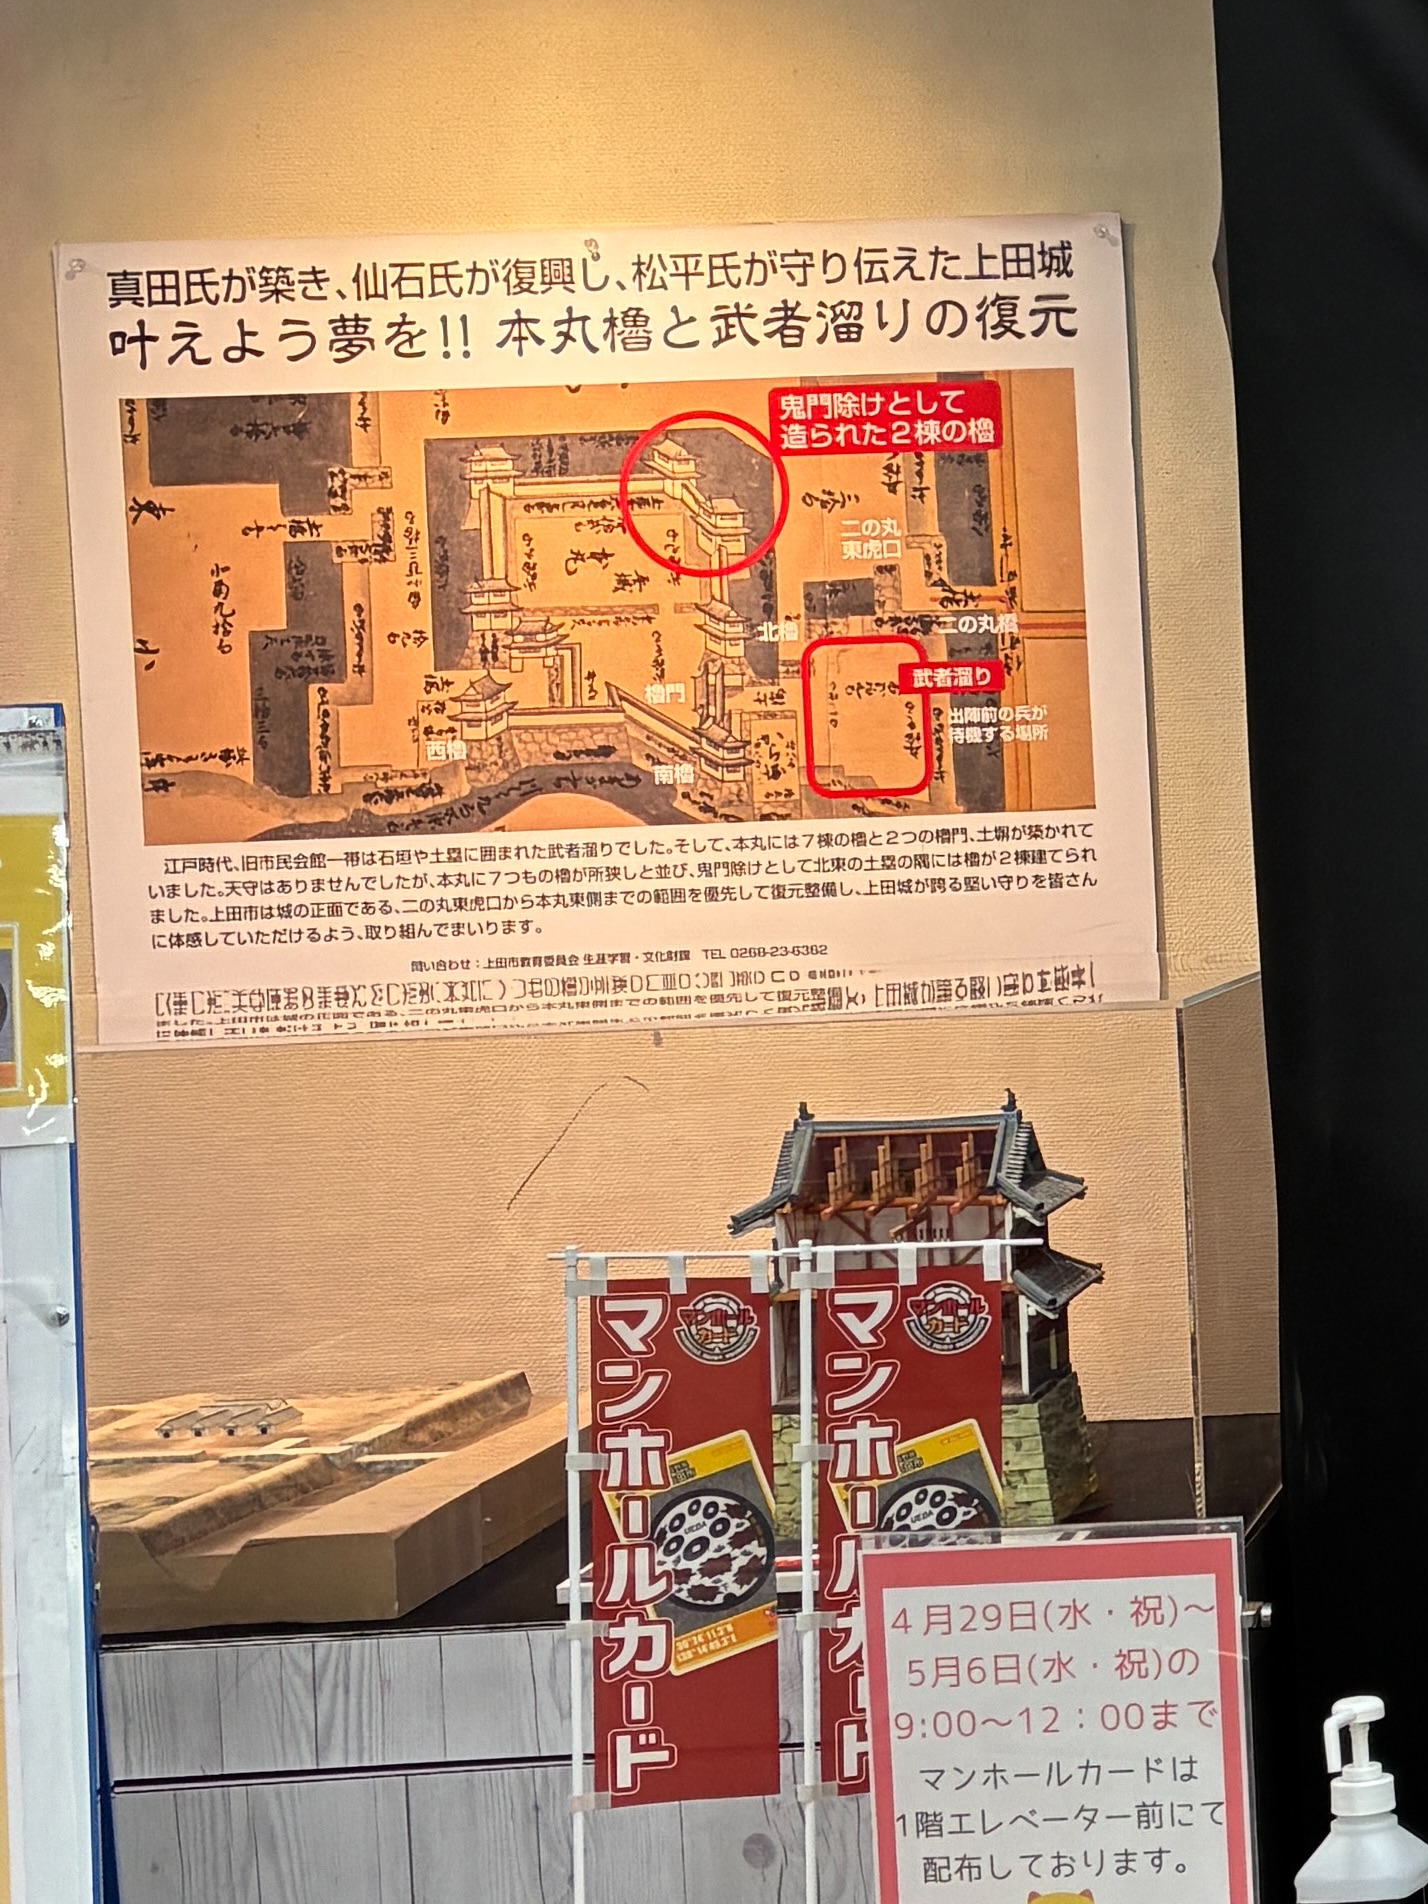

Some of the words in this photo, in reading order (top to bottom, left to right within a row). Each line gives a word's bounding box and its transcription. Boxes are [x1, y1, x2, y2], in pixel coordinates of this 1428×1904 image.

[106, 240, 1074, 310] 真田氏が築き、仙石氏が復興し、松平氏が守り伝えた上田城
[495, 292, 1079, 357] 本丸櫓と武者溜りの復元
[779, 389, 966, 421] 鬼門除けとして
[840, 516, 903, 538] 二の丸
[912, 665, 992, 689] 武者溜り
[701, 948, 727, 960] TEL
[600, 1296, 675, 1792] マンホールカード
[919, 1755, 1199, 1792] マンホールカードは
[895, 1797, 1226, 1840] 1階エレベーター前にて
[922, 1847, 1188, 1886] 配布しております。
